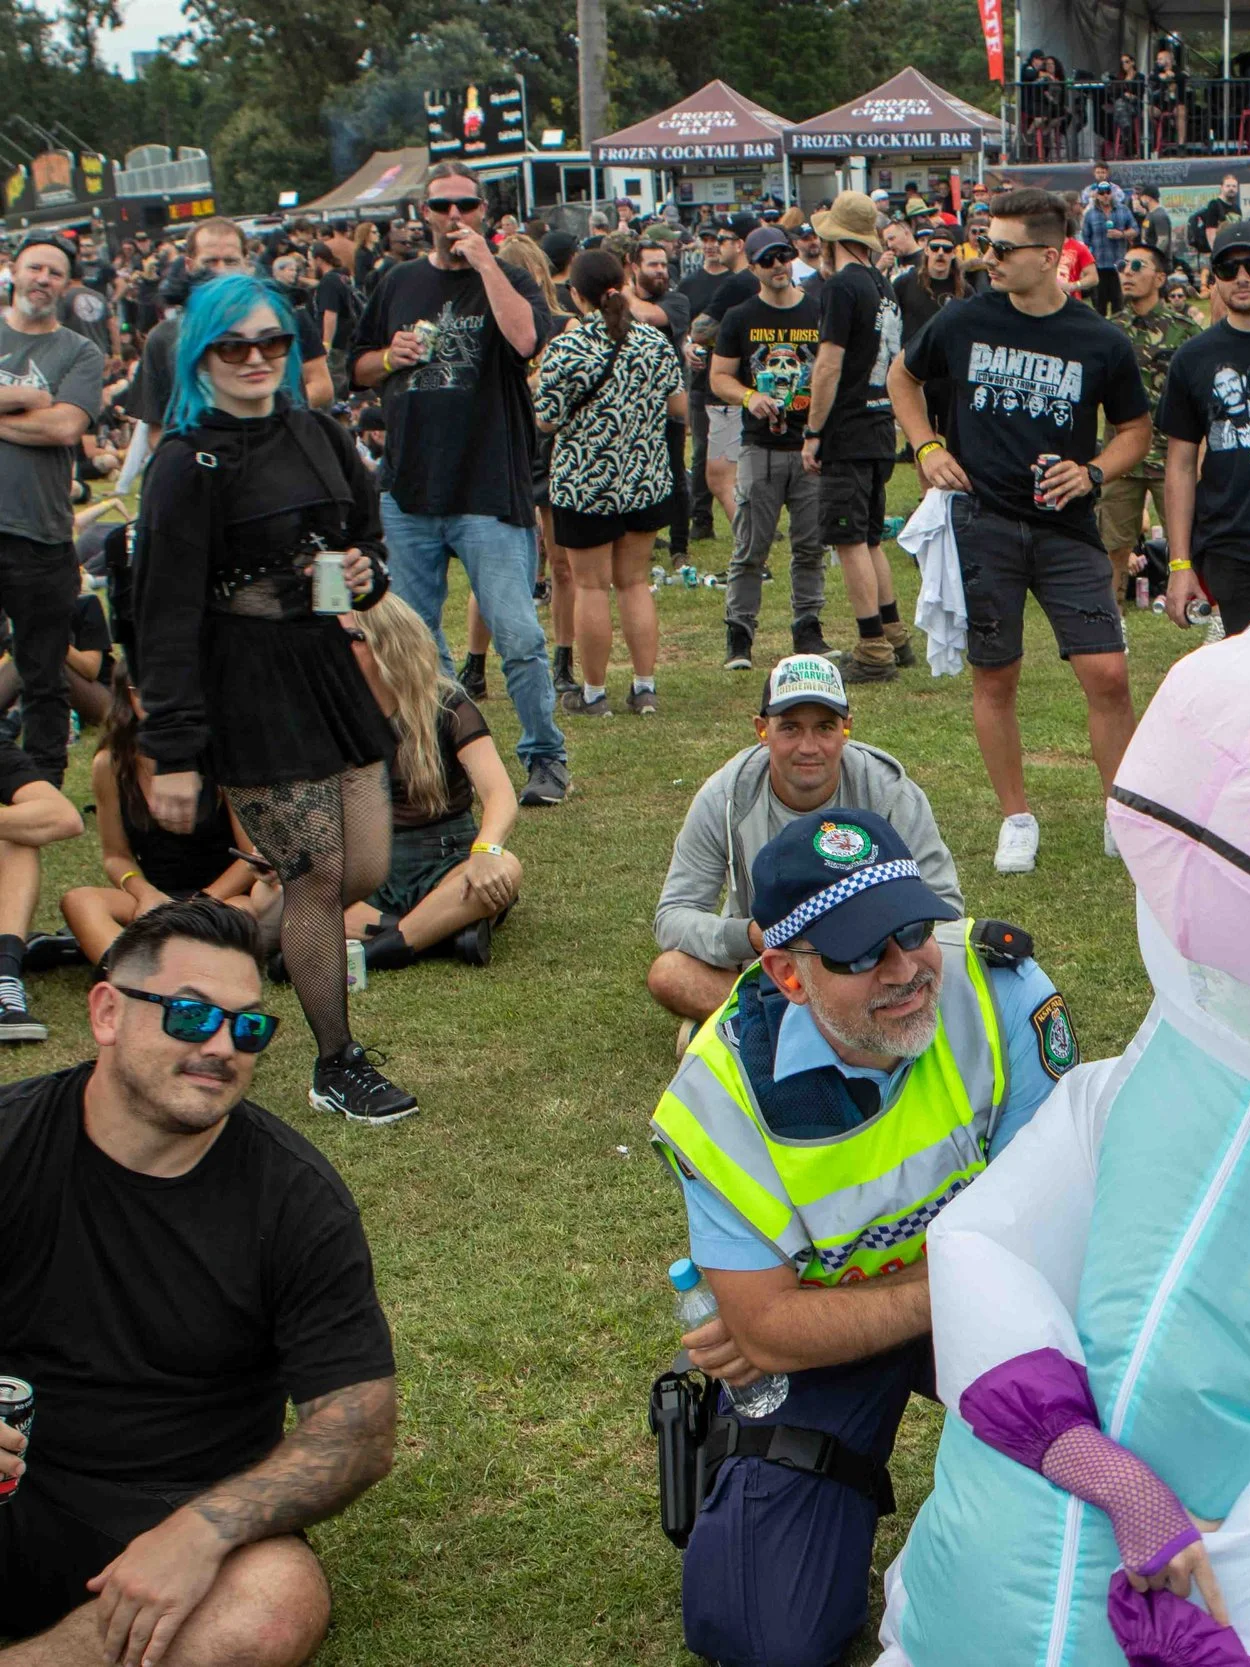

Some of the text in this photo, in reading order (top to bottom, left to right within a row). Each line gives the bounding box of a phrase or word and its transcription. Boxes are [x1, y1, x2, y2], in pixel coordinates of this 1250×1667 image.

[864, 99, 930, 108] FROZEN
[671, 111, 734, 121] FROZEN
[851, 107, 933, 116] COCKTAIL
[872, 114, 906, 123] BAR
[658, 119, 739, 129] COCKTAIL
[677, 127, 711, 136] BAR
[792, 131, 973, 149] FROZEN COCKTAIL BAR
[598, 143, 776, 162] FROZEN COCKTAIL BAR
[750, 328, 776, 342] GUNS
[790, 328, 819, 342] ROSES
[967, 341, 1083, 403] PANTERA
[977, 371, 1014, 387] COWBOYS
[1016, 379, 1037, 391] FROM
[792, 661, 820, 672] GREEN
